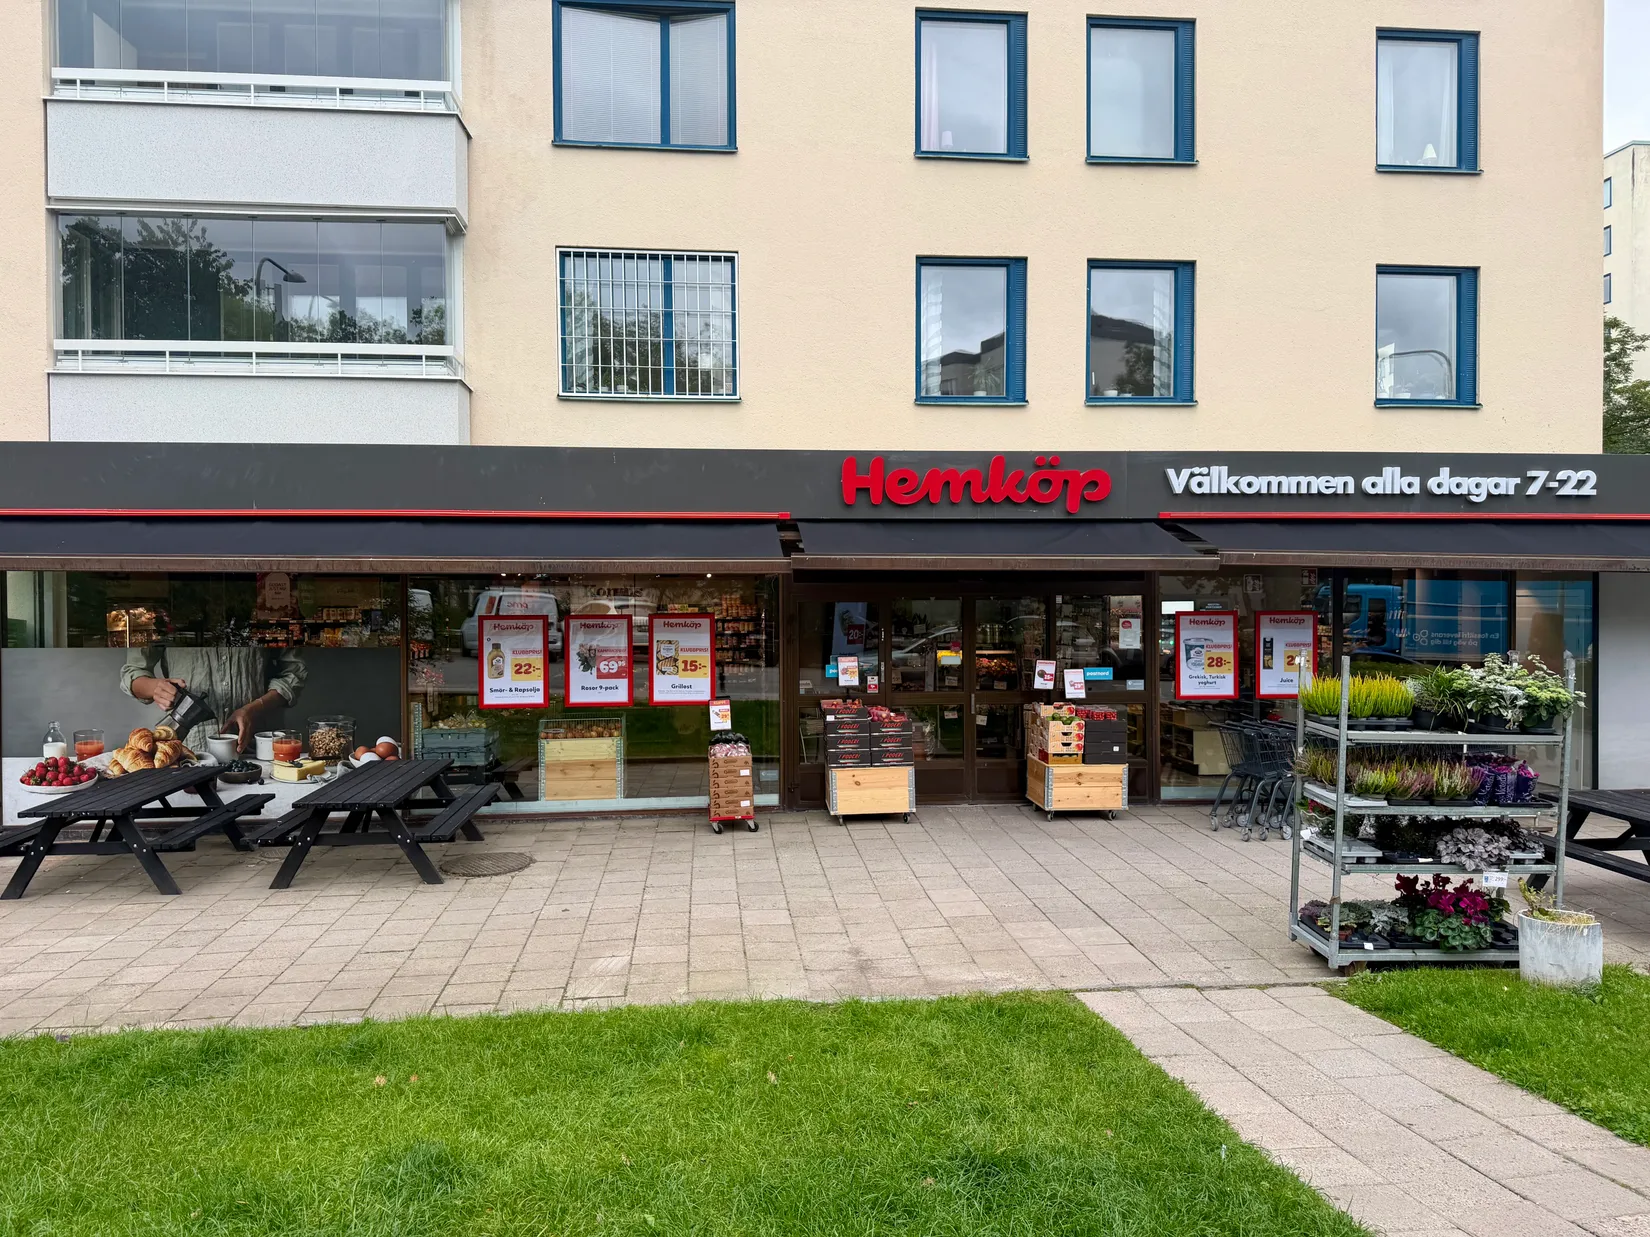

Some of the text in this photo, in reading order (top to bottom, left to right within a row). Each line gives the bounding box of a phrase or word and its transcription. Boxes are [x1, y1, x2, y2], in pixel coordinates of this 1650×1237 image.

[842, 455, 1111, 513] Hemköp
[1165, 466, 1598, 503] Välkommen alla dagar 7-22
[663, 621, 702, 629] Hemköp
[1189, 618, 1226, 626] Hemköp
[1269, 617, 1305, 625] Hemköp
[493, 623, 534, 632] Hemköp
[681, 660, 707, 672] 15:-
[1207, 656, 1231, 668] 28:-
[514, 663, 541, 675] 22:-
